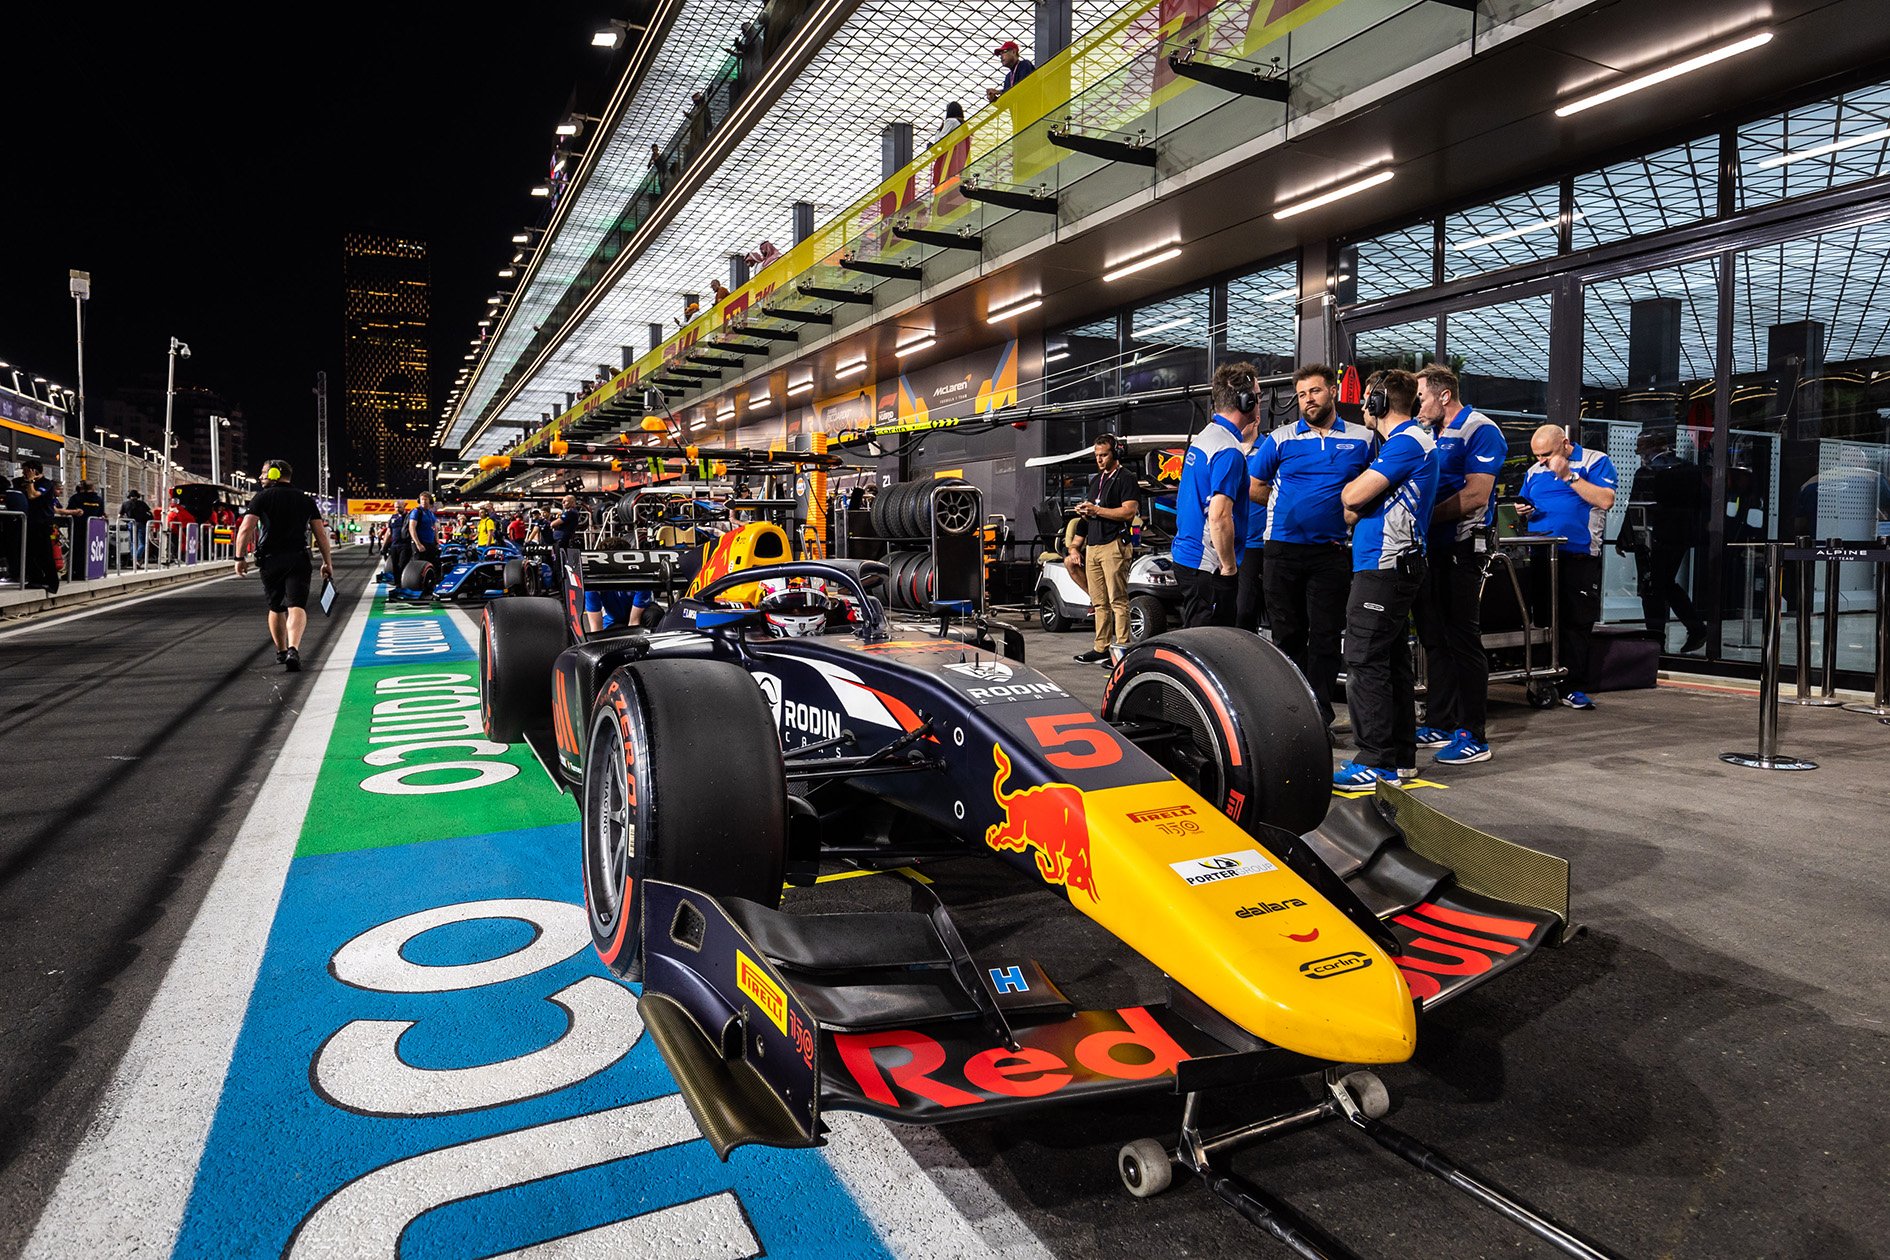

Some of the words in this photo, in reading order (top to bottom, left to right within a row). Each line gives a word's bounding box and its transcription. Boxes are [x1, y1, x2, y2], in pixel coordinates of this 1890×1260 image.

[932, 381, 968, 398] McLaren
[883, 475, 892, 488] 21
[90, 535, 104, 562] stc
[188, 536, 197, 554] stc
[580, 551, 680, 565] ROD
[966, 681, 1062, 699] RODIN
[784, 700, 841, 740] RODIN
[359, 673, 520, 795] aramco
[1024, 712, 1124, 770] 5
[614, 697, 638, 807] ZERO
[1126, 804, 1198, 824] PIRELLI
[1235, 898, 1309, 919] dallara
[1313, 956, 1361, 973] carlin
[741, 961, 783, 1023] PIRELLI
[834, 1006, 1193, 1109] Red
